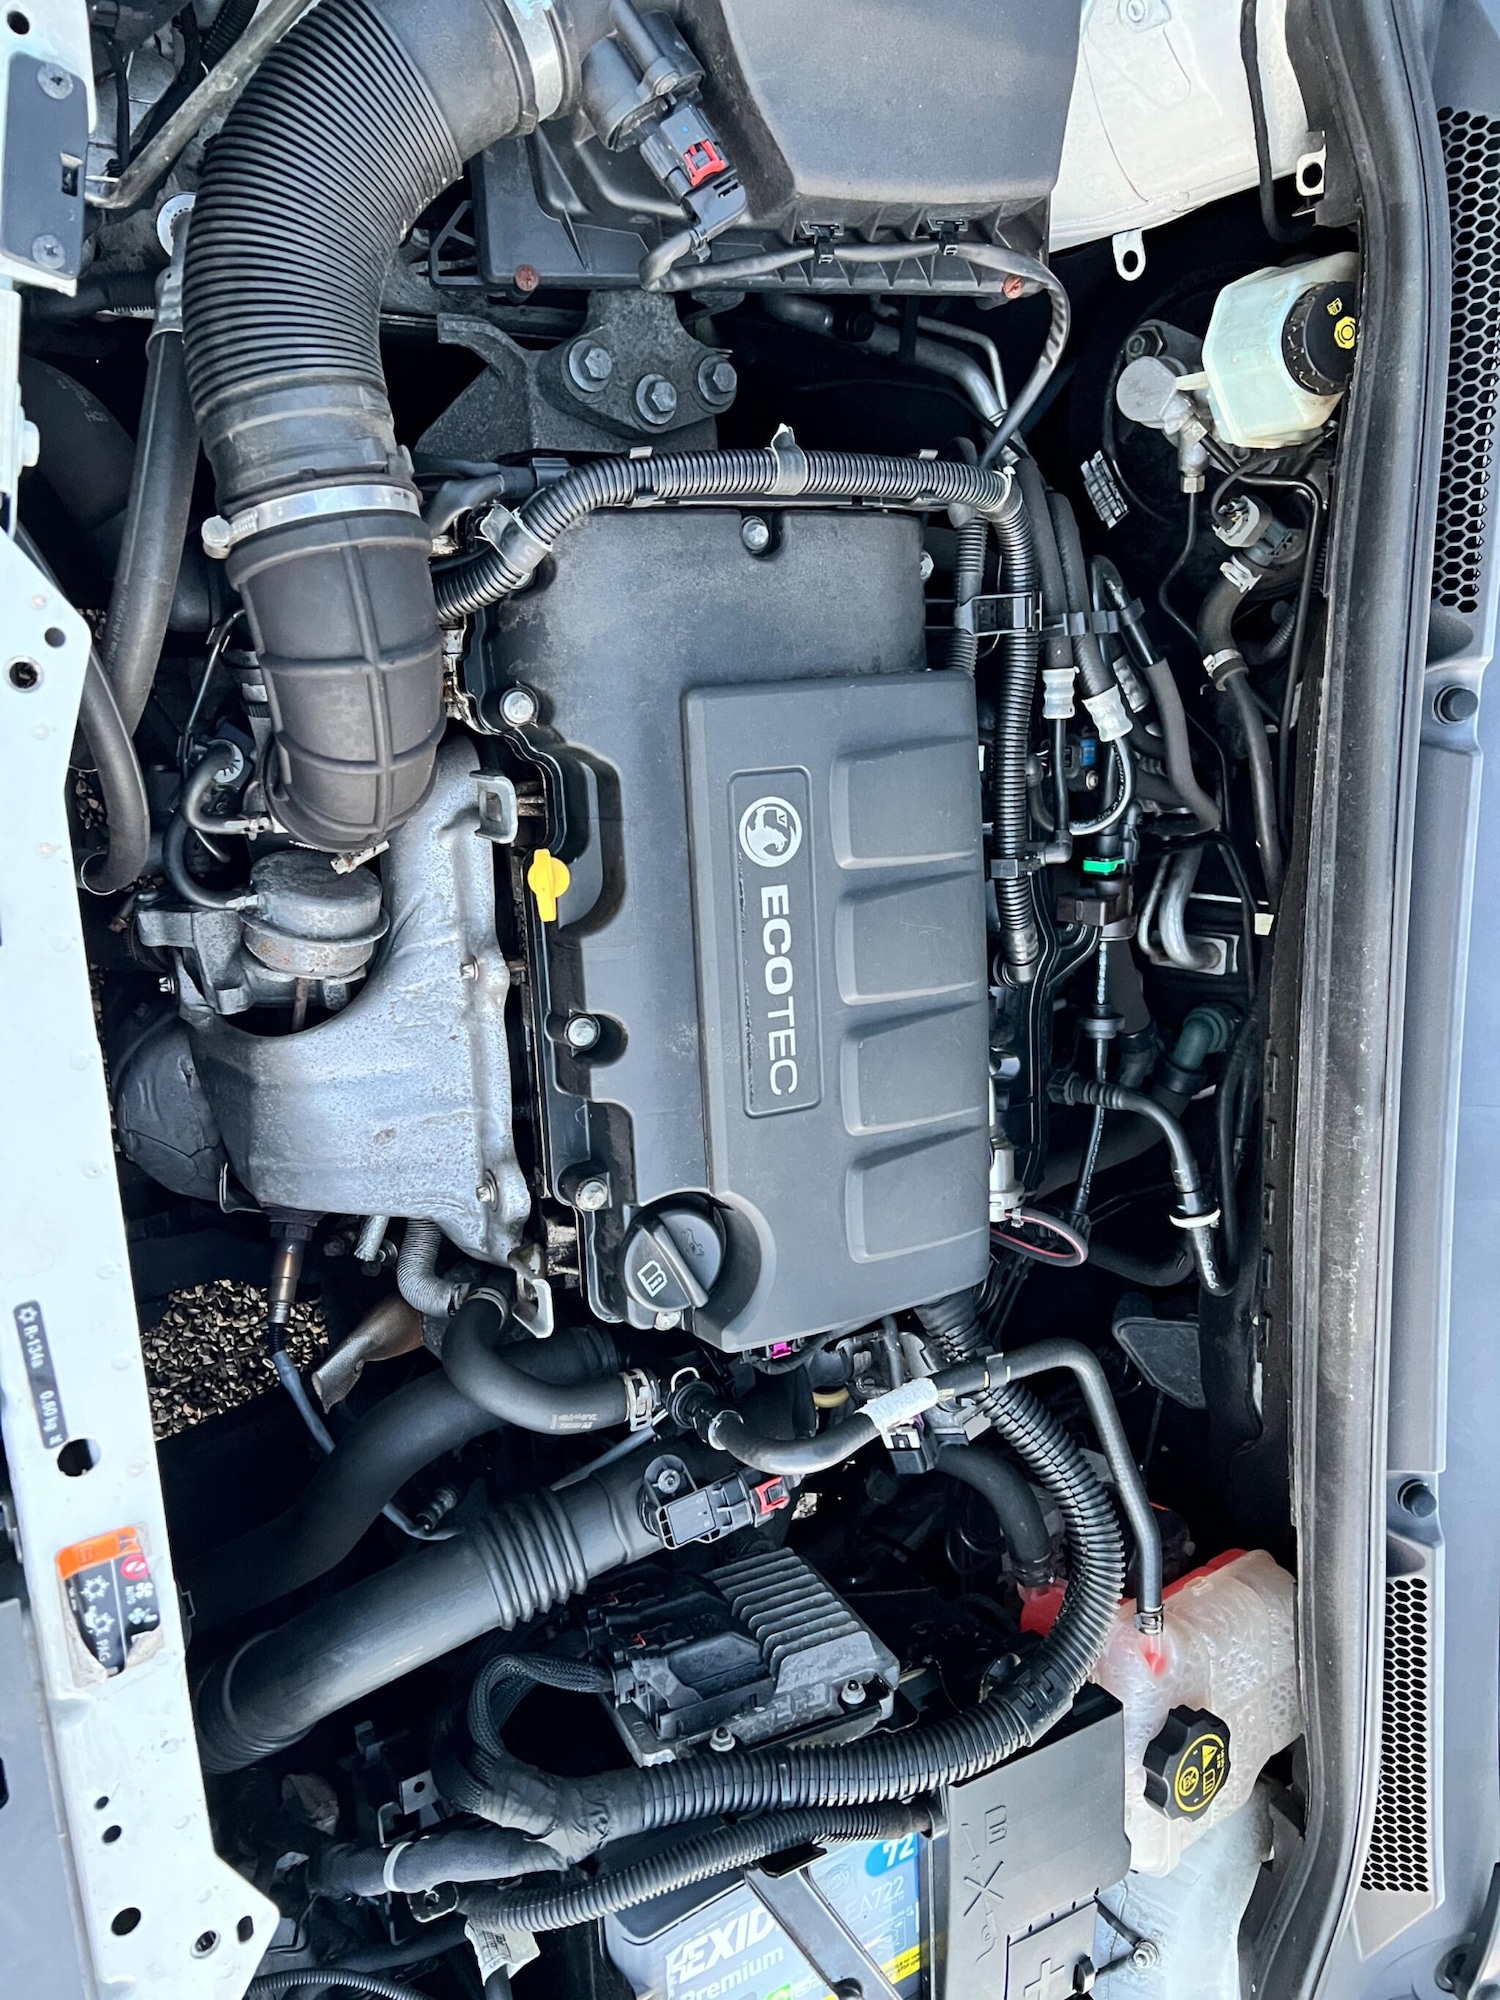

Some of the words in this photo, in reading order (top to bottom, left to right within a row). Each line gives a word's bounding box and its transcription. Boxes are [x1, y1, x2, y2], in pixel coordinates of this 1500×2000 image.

[760, 884, 799, 1096] ECOTEC
[23, 1324, 44, 1369] R-134a
[44, 1416, 58, 1432] kg
[96, 1638, 111, 1662] PAG
[882, 1835, 915, 1868] 72
[845, 1875, 905, 1920] EA722
[674, 1907, 784, 1984] EXID
